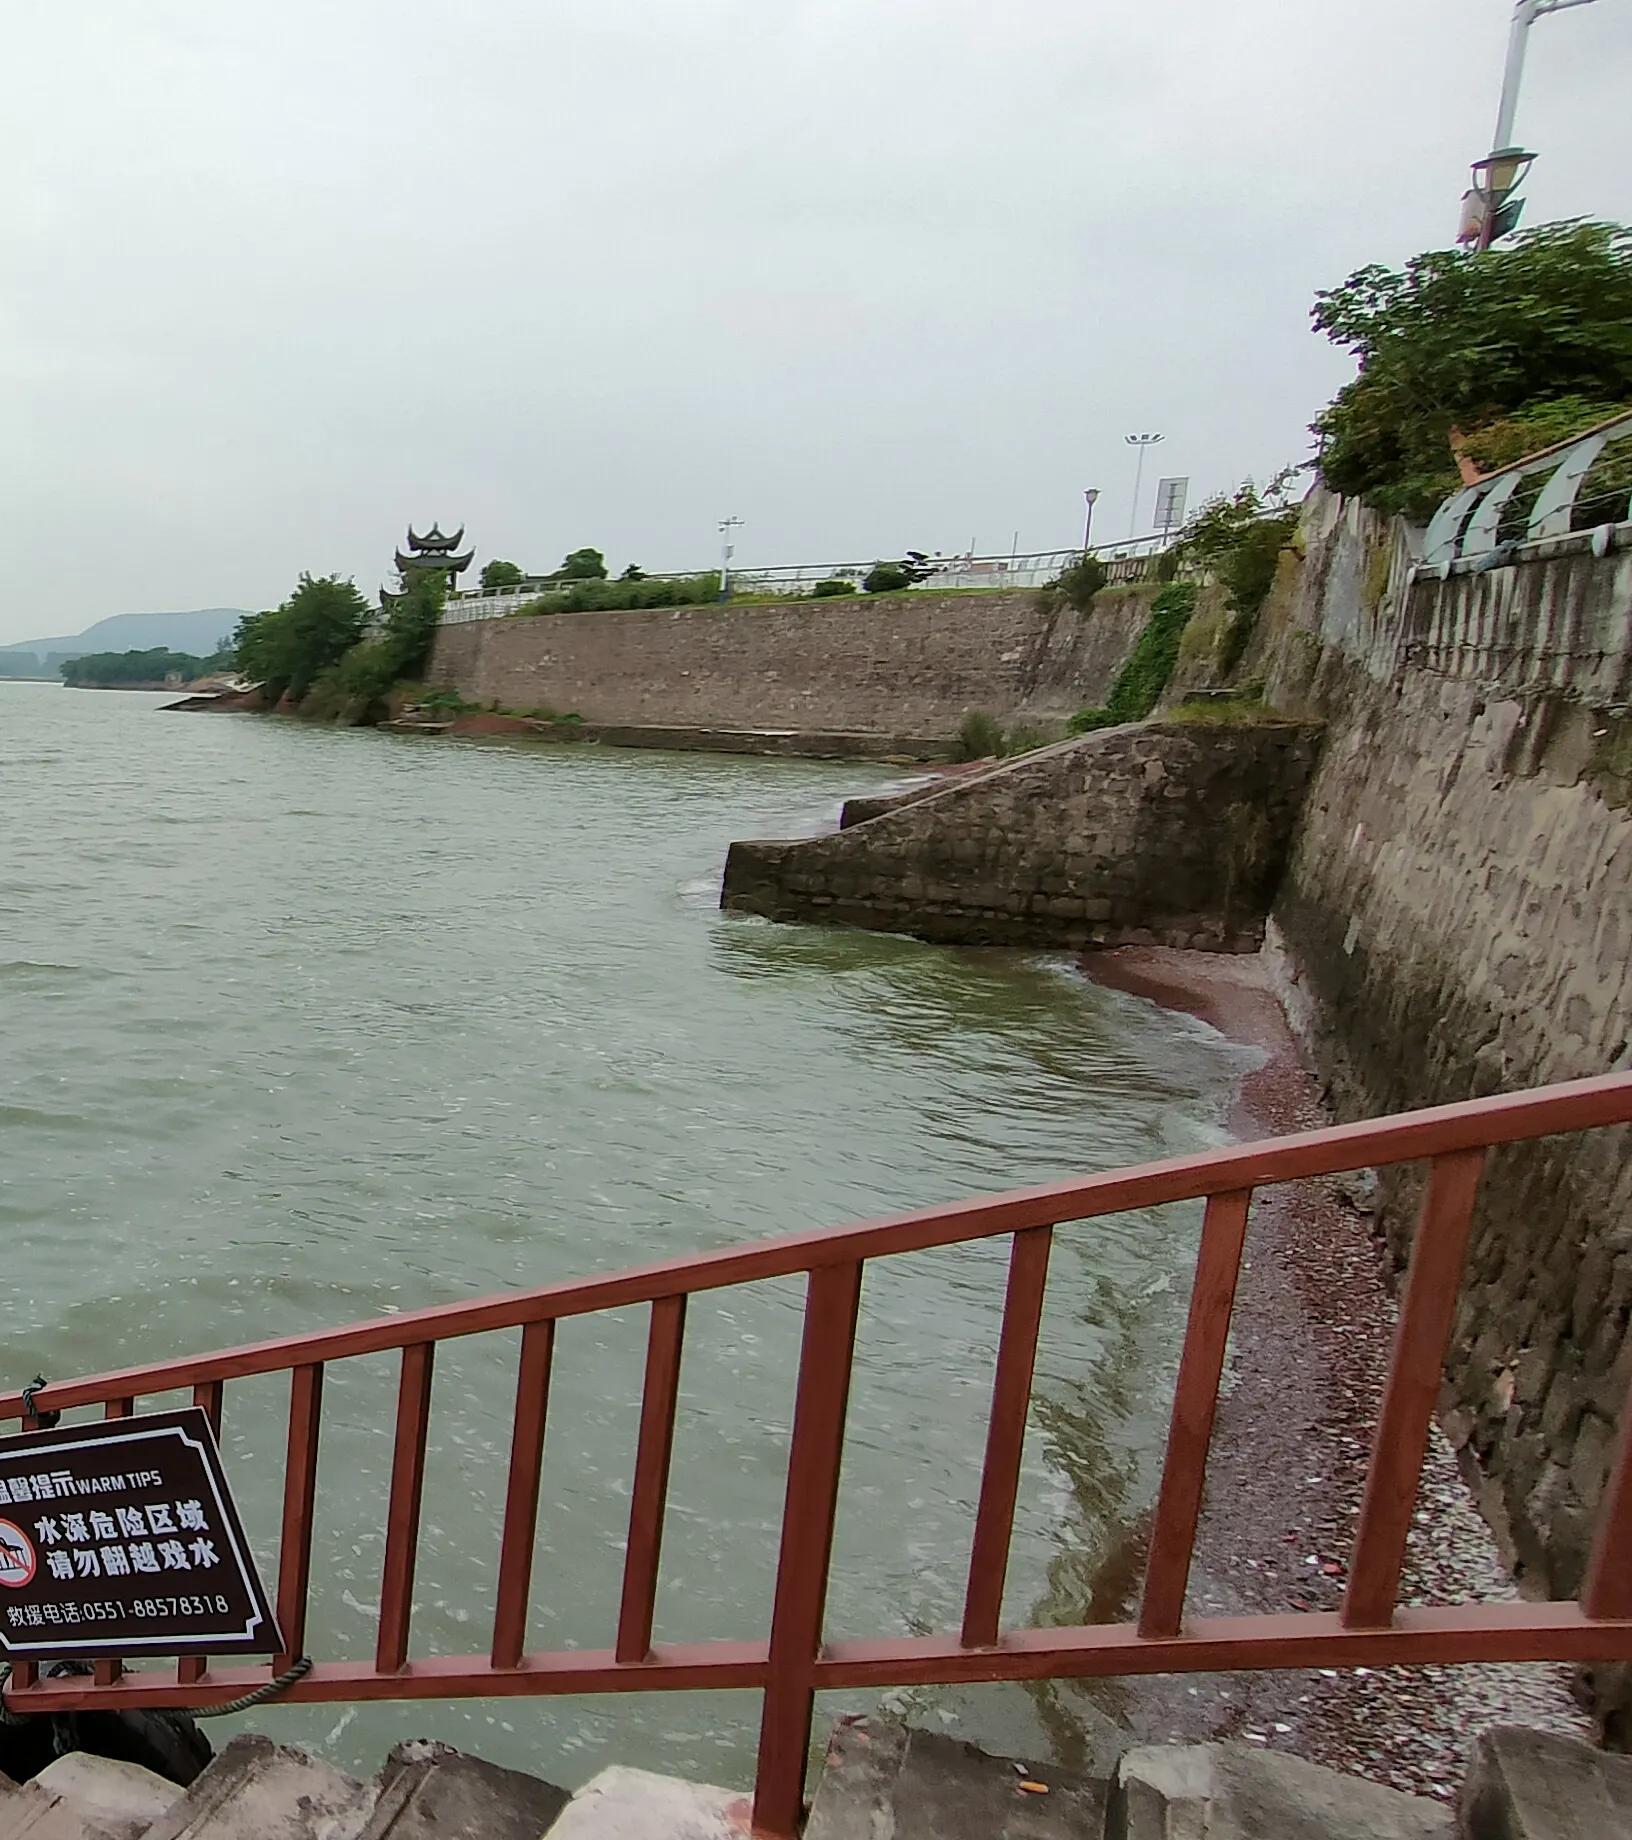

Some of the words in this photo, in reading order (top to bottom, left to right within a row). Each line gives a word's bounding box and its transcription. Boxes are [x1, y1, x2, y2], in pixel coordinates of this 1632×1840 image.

[75, 1474, 127, 1495] WARM
[125, 1470, 163, 1489] TIPS
[33, 1499, 210, 1545] 水深危险区域
[46, 1537, 220, 1580] 请勿翻越戏水
